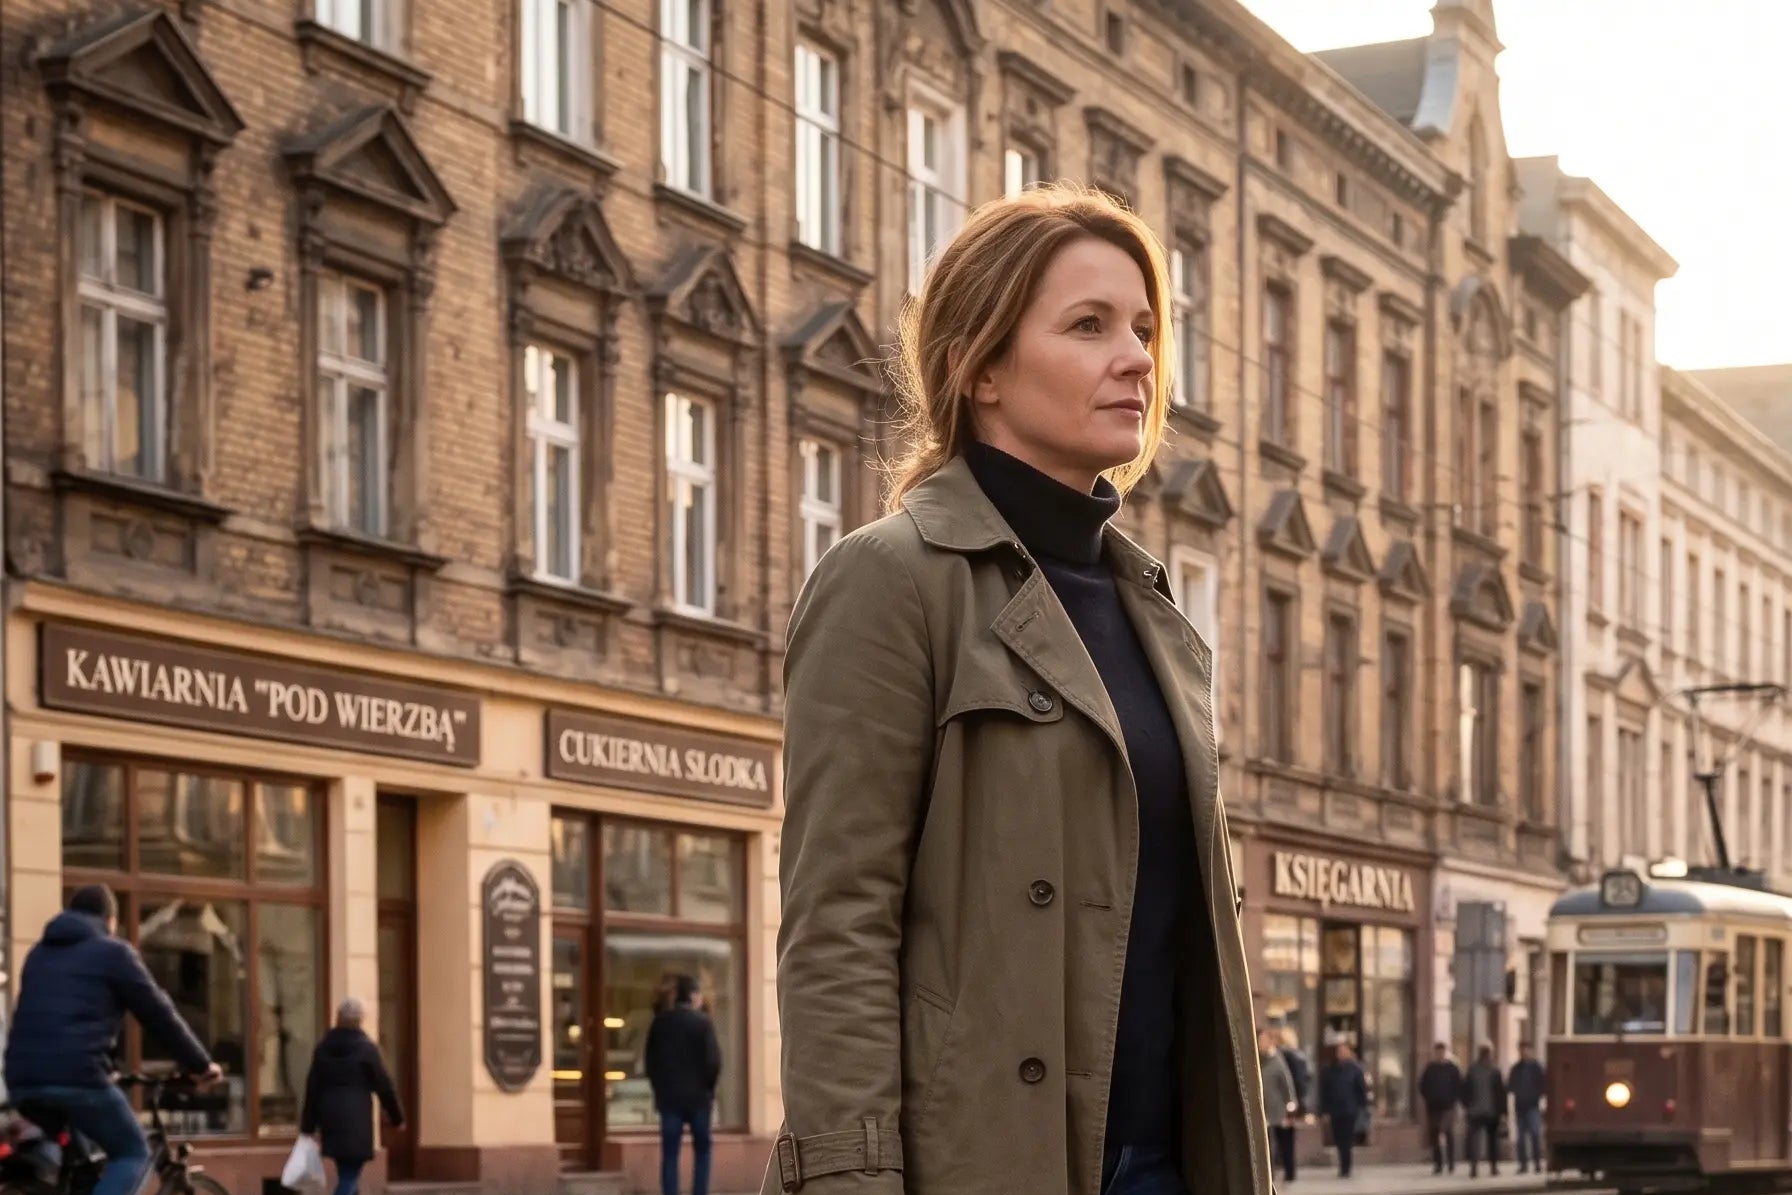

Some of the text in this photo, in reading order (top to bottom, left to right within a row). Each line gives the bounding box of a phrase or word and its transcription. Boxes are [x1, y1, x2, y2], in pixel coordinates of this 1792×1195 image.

[66, 648, 467, 753] KAWIARNIA "POD WIERZBĄ"
[559, 729, 683, 779] CUKIERNIA
[1275, 851, 1415, 913] KSIĘGARNIA
